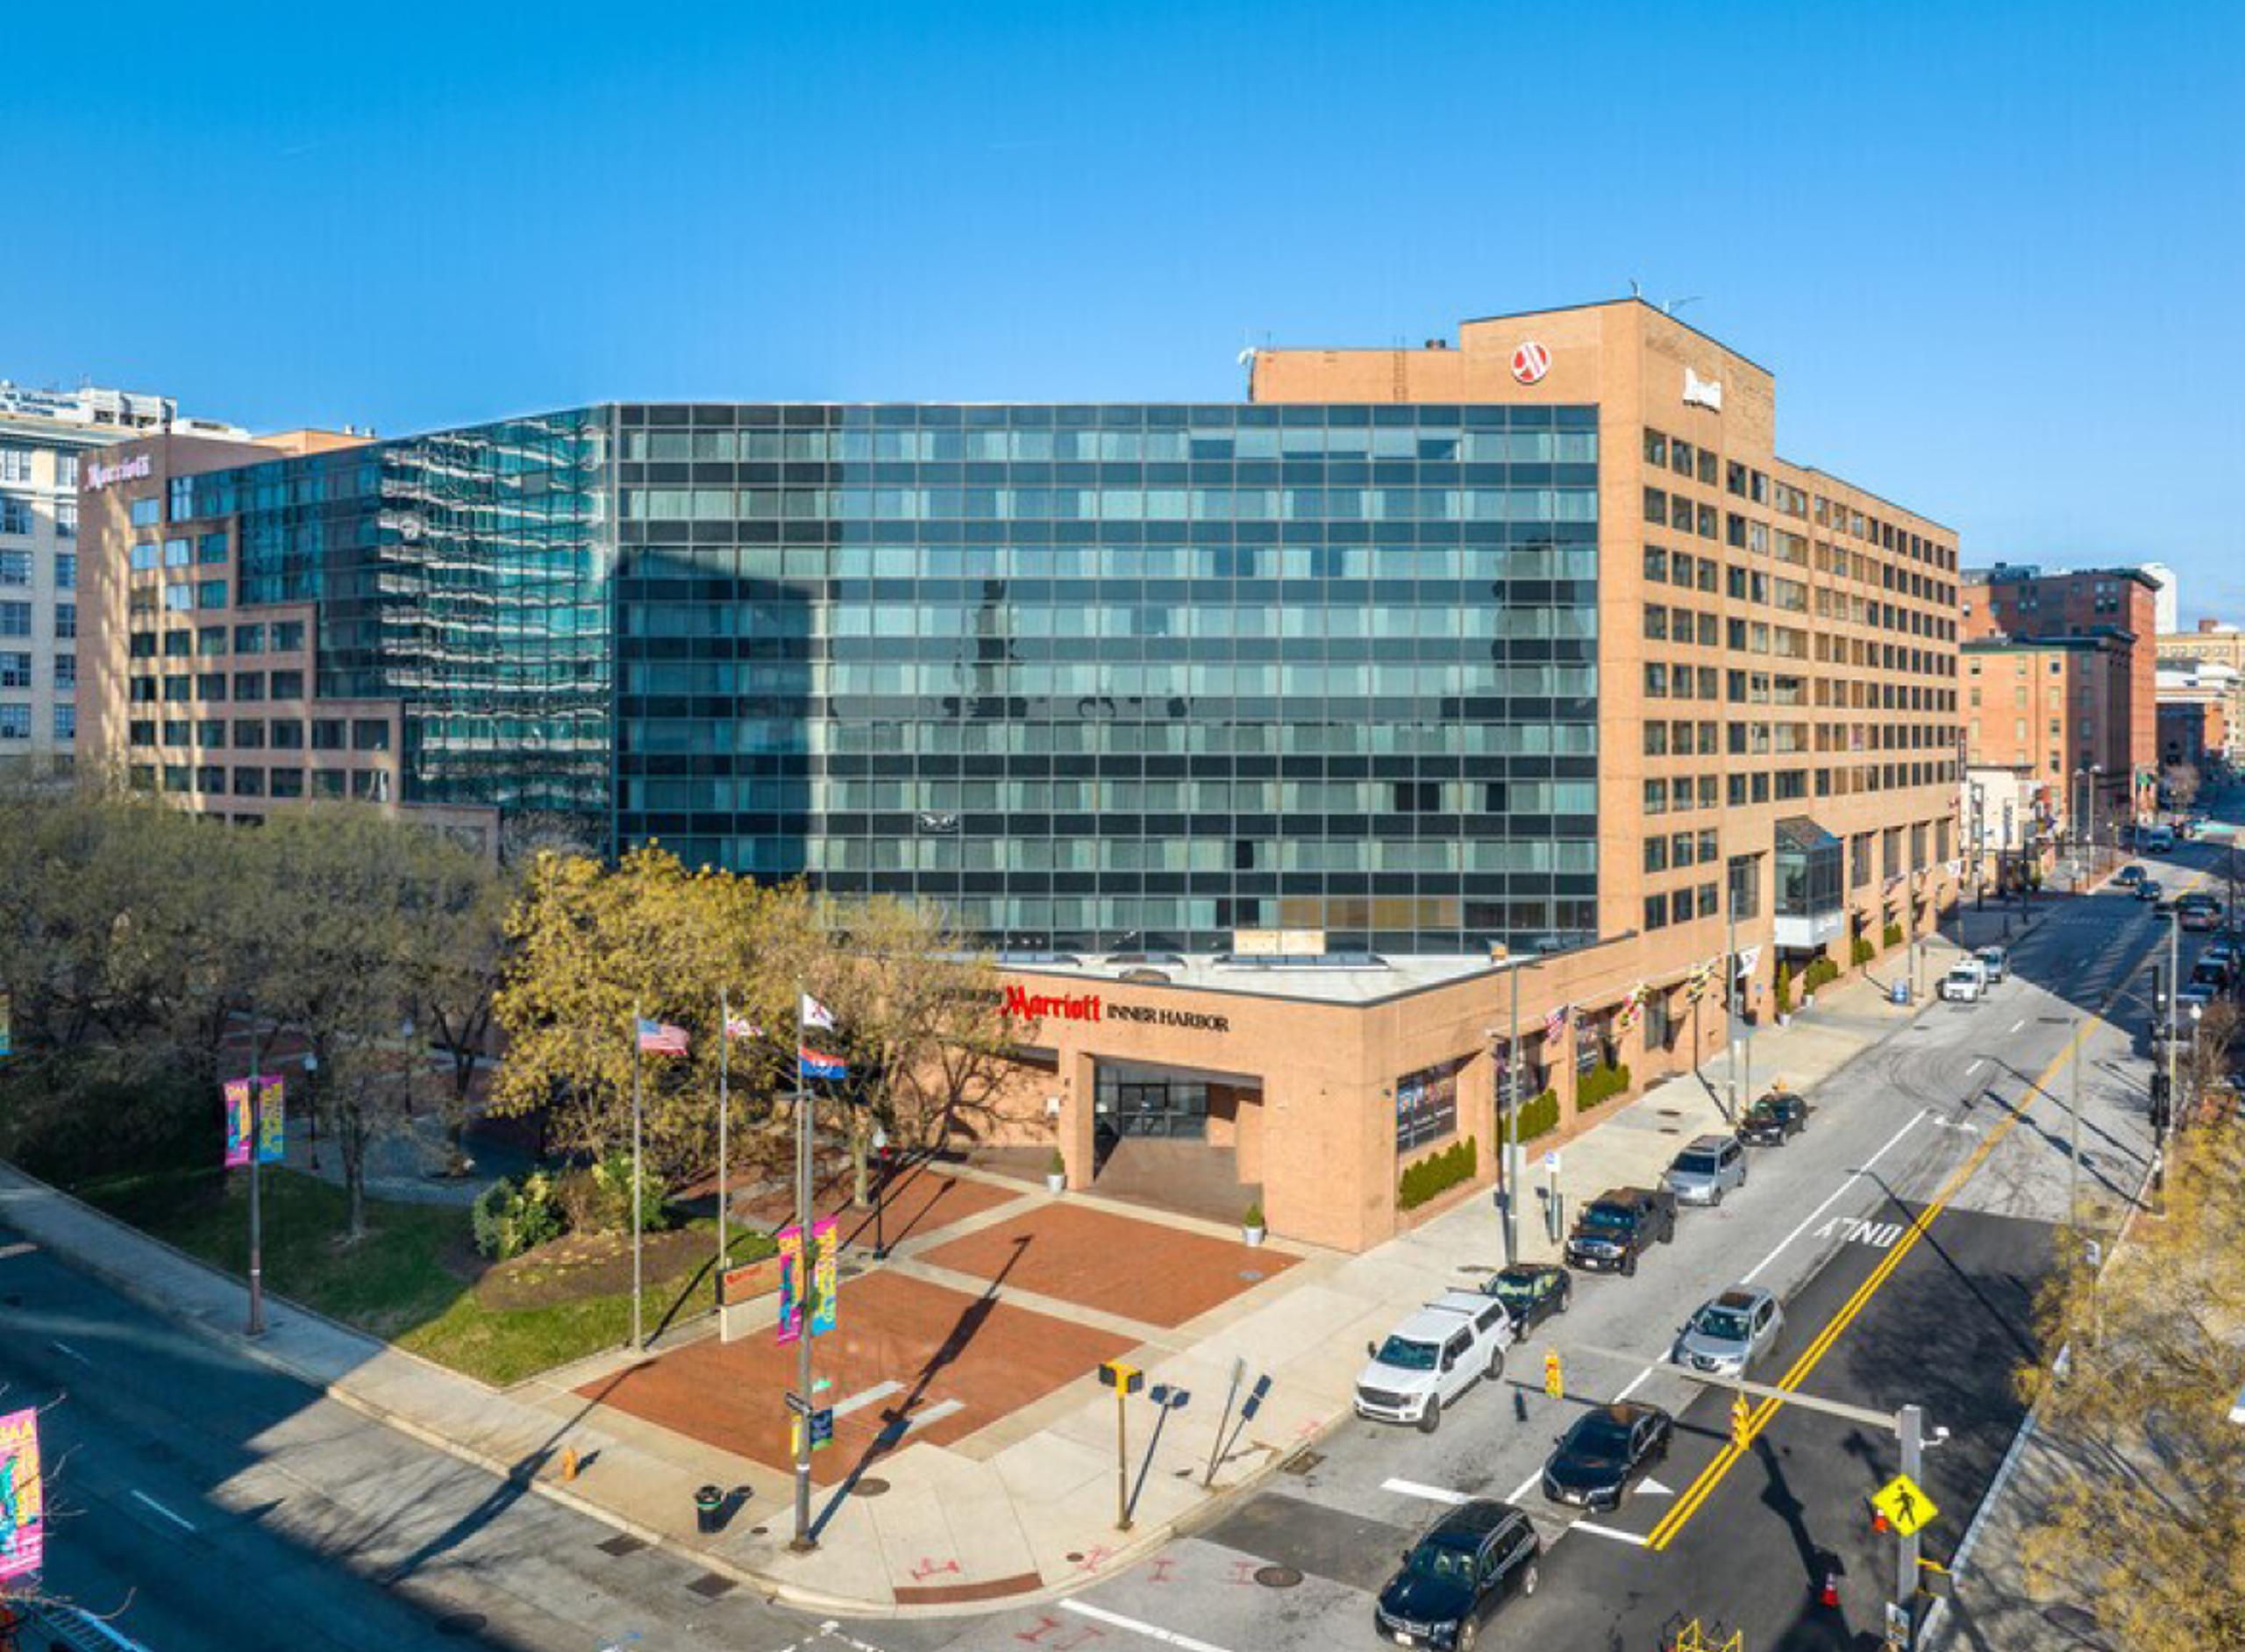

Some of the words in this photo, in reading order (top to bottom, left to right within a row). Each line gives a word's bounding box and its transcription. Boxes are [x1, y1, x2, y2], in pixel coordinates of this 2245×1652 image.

[1000, 985, 1101, 1022] Marriott
[1107, 1003, 1158, 1024] INNER
[1158, 1009, 1231, 1033] HARBOR
[1813, 1217, 1904, 1247] ONLY
